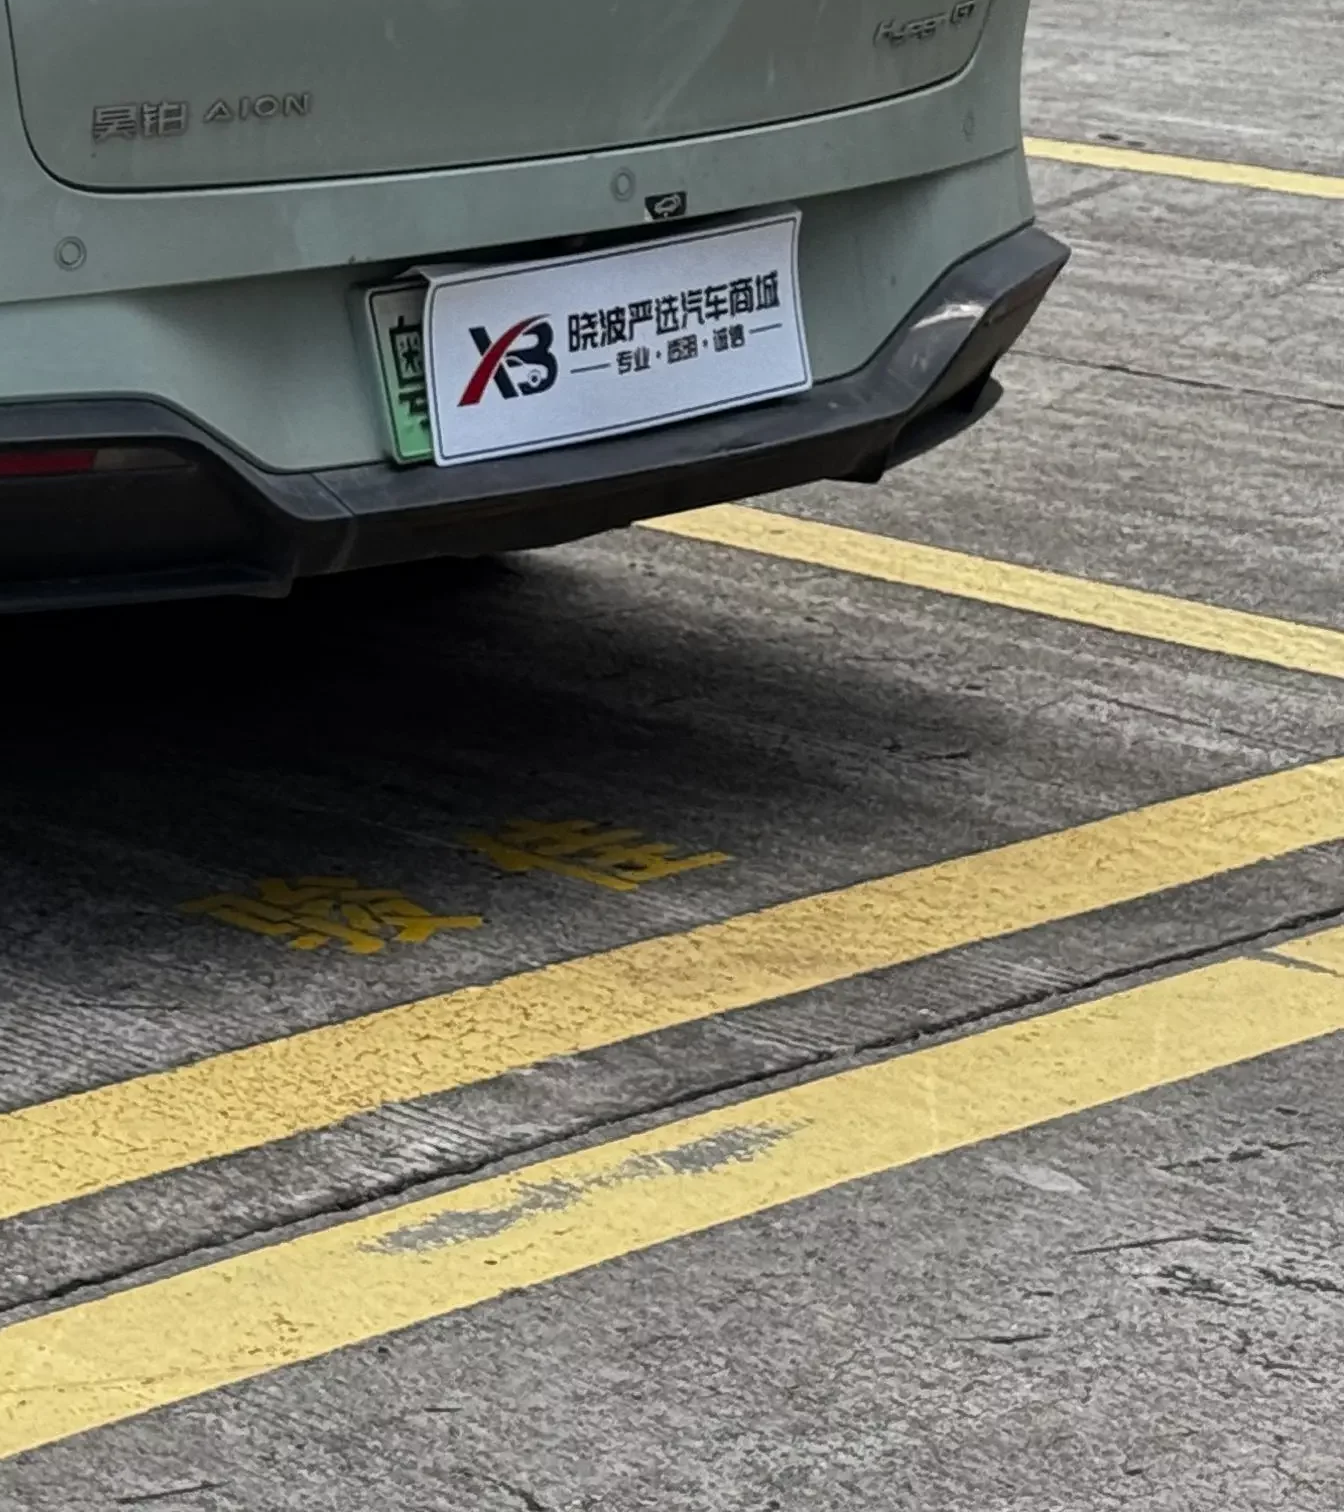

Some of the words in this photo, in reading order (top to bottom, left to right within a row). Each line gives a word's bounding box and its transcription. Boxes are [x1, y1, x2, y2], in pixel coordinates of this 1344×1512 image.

[93, 101, 189, 144] 昊铂
[203, 92, 313, 124] AION
[567, 269, 781, 353] 晓波严选汽车商城
